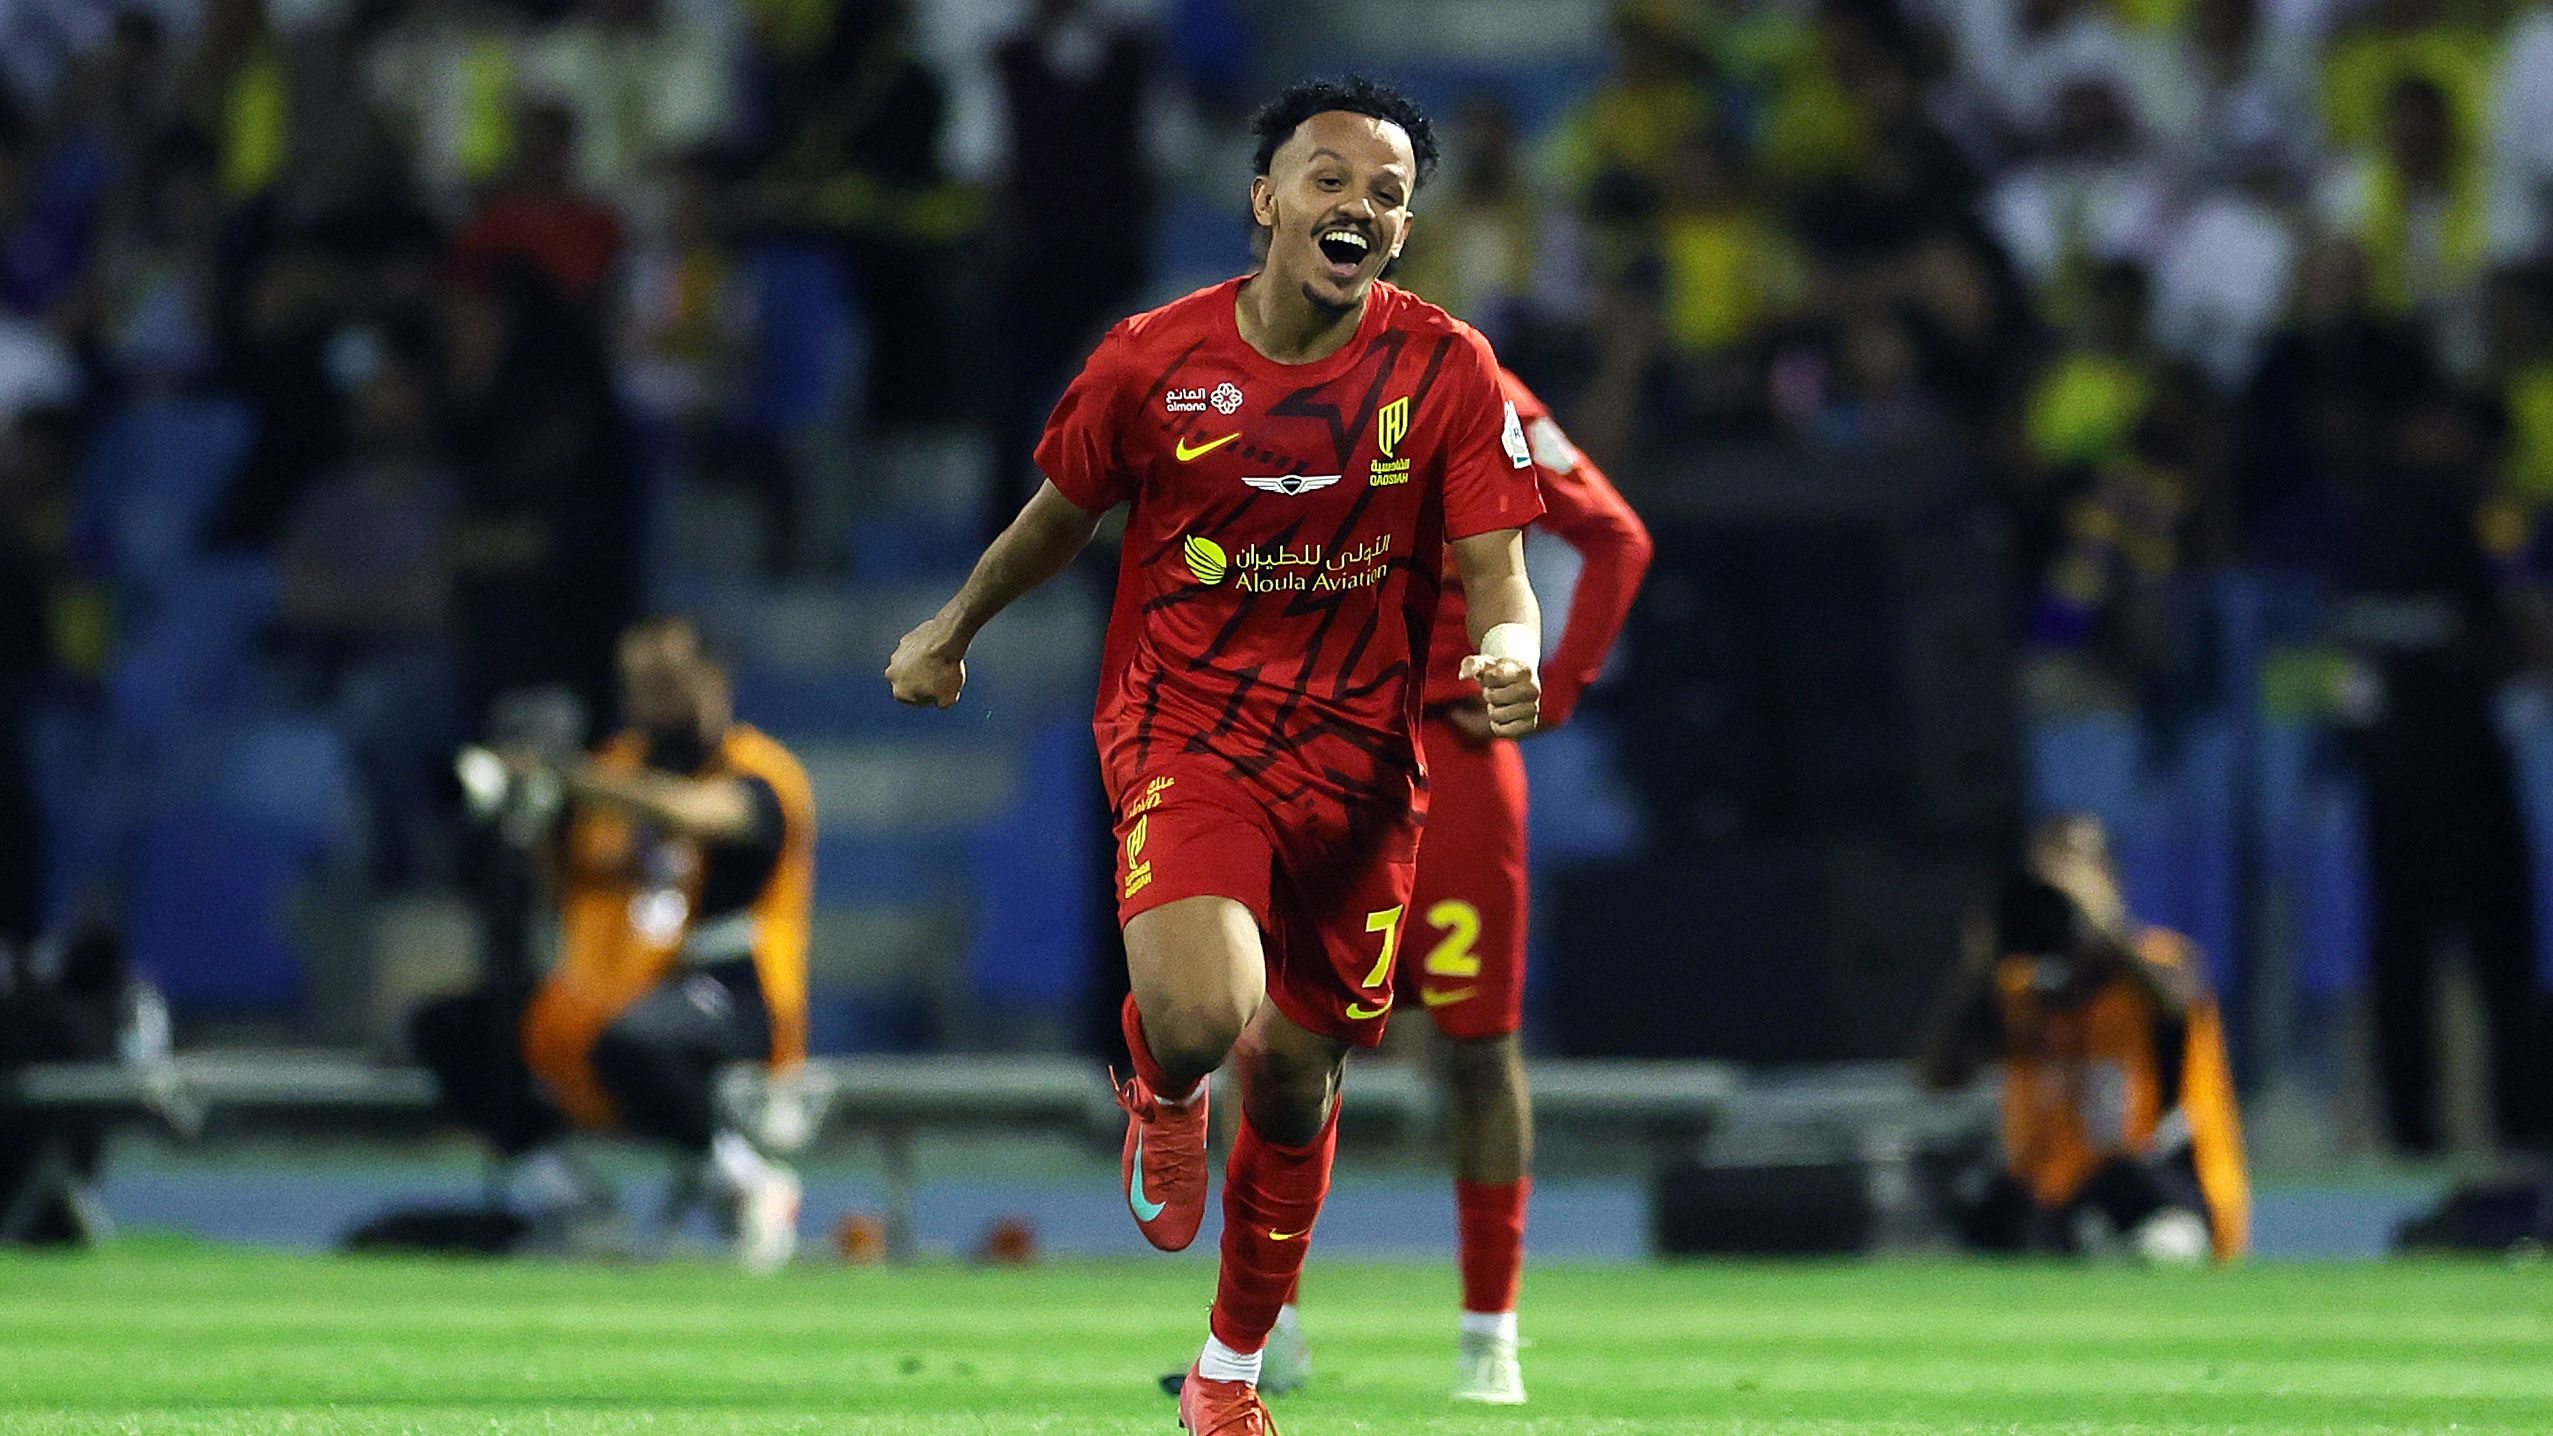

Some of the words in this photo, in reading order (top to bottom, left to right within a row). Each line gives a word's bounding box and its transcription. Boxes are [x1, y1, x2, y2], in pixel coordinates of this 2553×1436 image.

[1166, 388, 1206, 404] المانع
[1235, 543, 1321, 571] للطيران
[1235, 571, 1306, 593] Aloula
[1312, 564, 1387, 592] Aviation
[1361, 904, 1404, 988] 7
[1425, 899, 1482, 977] 2
